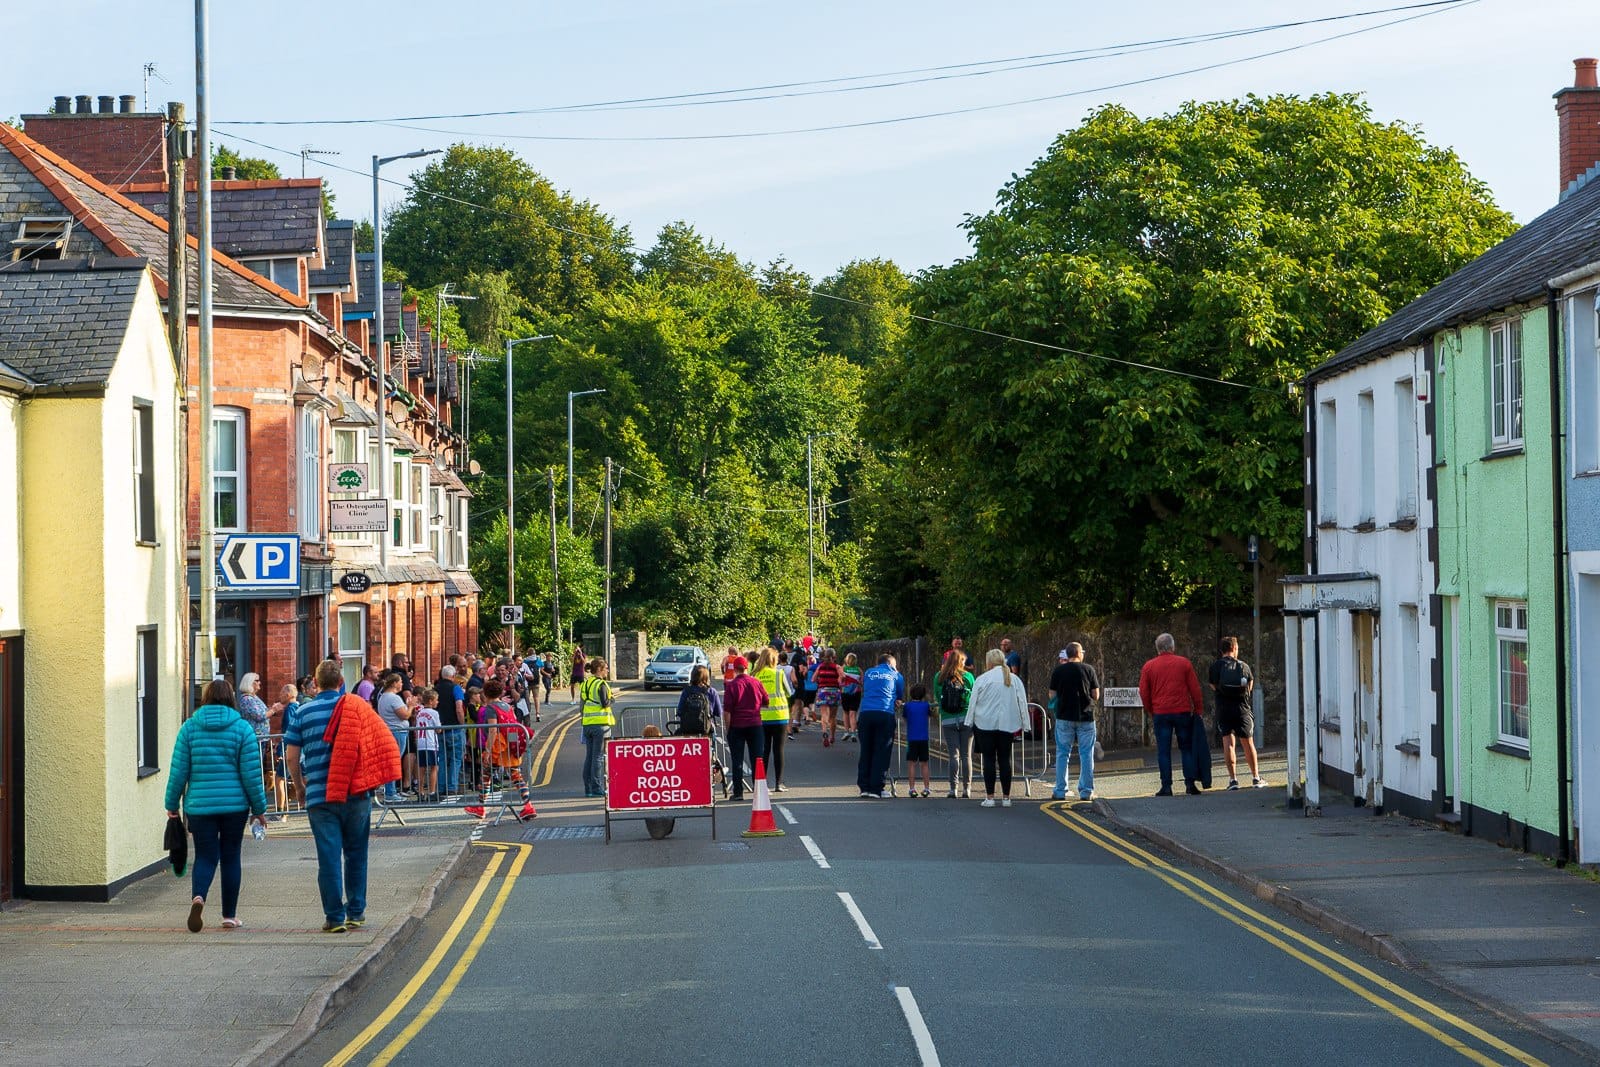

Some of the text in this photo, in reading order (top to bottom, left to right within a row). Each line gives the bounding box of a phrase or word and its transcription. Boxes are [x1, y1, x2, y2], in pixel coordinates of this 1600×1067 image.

[262, 545, 284, 577] P
[360, 576, 366, 584] 2
[615, 742, 702, 758] FFORDD AR
[642, 759, 676, 772] GAU
[637, 775, 682, 789] ROAD
[629, 789, 691, 804] CLOSED
